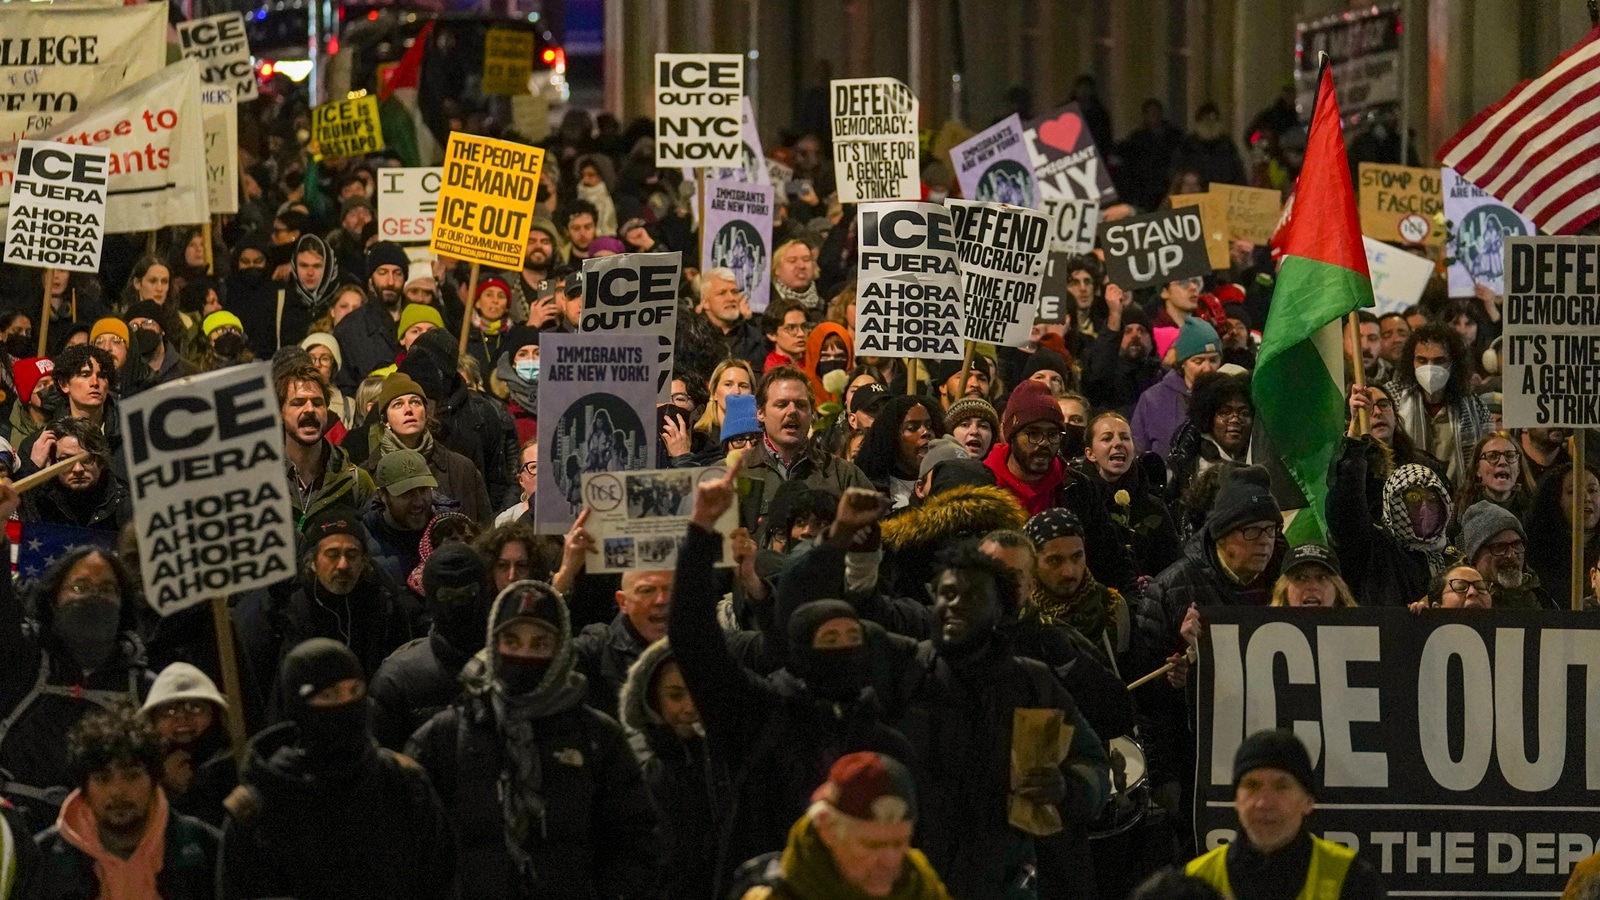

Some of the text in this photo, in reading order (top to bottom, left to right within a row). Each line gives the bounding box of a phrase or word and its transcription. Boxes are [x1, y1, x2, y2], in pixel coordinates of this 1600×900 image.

[181, 17, 243, 48] ICE
[0, 35, 98, 66] LLEGE
[221, 40, 244, 55] OF
[660, 61, 740, 89] ICE
[0, 92, 78, 112] E TO
[202, 89, 232, 104] HERS
[659, 92, 739, 106] OUT OF
[836, 84, 913, 116] DEFEND
[26, 115, 53, 131] FOR
[142, 109, 178, 132] to
[318, 102, 352, 124] ICE
[834, 115, 913, 136] DEMOCRACY:
[660, 117, 739, 137] NYC
[453, 140, 539, 174] THE PEOPLE
[660, 142, 739, 159] NOW
[838, 141, 915, 162] IT'S TIME FOR
[1023, 127, 1049, 168] I
[18, 148, 106, 185] ICE
[847, 160, 908, 181] A GENERAL
[1039, 157, 1101, 200] NY
[1362, 168, 1412, 189] STOMP
[14, 180, 103, 204] FUERA
[448, 162, 534, 202] DEMAND
[856, 180, 901, 200] STRIKE!
[1420, 175, 1440, 195] OU
[1450, 187, 1469, 198] ARE
[711, 199, 769, 216] ARE NEW YORK!
[716, 187, 766, 204] IMMIGRANTS
[13, 205, 100, 226] AHORA
[440, 196, 527, 240] ICE OUT
[11, 219, 98, 240] AHORA
[437, 228, 522, 254] OF OUR COMMUNITIES!
[862, 210, 957, 252] ICE
[950, 204, 1048, 254] DEFEND
[1106, 214, 1201, 256] STAND
[10, 233, 96, 254] AHORA
[8, 247, 94, 267] AHORA
[861, 252, 961, 276] FUERA
[956, 240, 1041, 276] MOCRACY:
[1127, 244, 1184, 282] UP
[1511, 244, 1600, 294] DEFE
[585, 265, 678, 309] ICE
[862, 282, 961, 302] AHORA
[966, 271, 1037, 304] TIME FOR
[582, 306, 674, 332] OUT OF
[861, 300, 960, 320] AHORA
[964, 293, 1020, 324] ENERAL
[860, 317, 960, 337] AHORA
[964, 315, 1007, 343] RIKE!
[557, 346, 642, 363] IMMIGRANTS
[860, 334, 959, 354] AHORA
[1509, 335, 1547, 365] IT'S
[548, 365, 574, 381] ARE
[578, 365, 607, 381] NEW
[610, 365, 649, 382] YORK!
[1522, 365, 1600, 395] A GENE
[127, 376, 276, 465] ICE
[1536, 394, 1600, 425] STRIK
[135, 440, 279, 499] FUERA
[146, 482, 283, 538] AHORA
[150, 506, 284, 562] AHORA
[152, 530, 286, 585] AHORA
[157, 553, 288, 608] AHORA
[1210, 621, 1389, 788] ICE
[1370, 831, 1476, 874] THE
[1487, 832, 1600, 874] DEP
